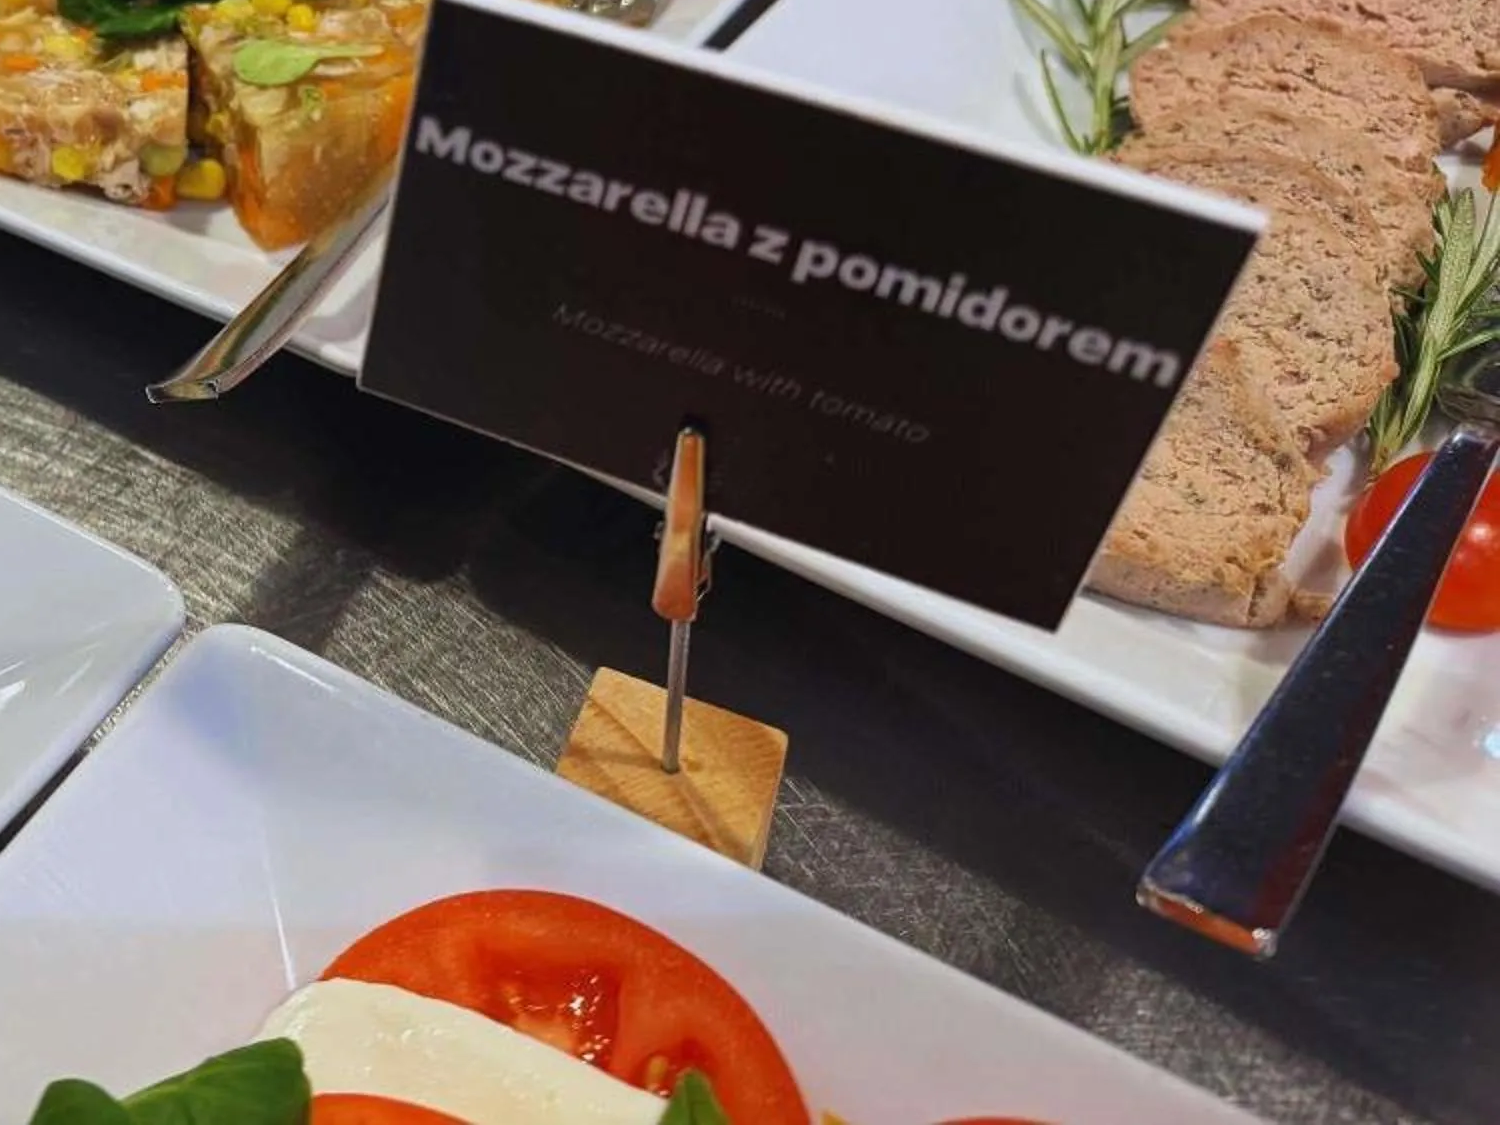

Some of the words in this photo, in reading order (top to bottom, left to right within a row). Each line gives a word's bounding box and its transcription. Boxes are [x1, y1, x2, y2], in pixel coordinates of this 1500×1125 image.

[414, 115, 739, 251] Mozzarella
[748, 225, 791, 265] z
[791, 241, 1182, 388] pomidorem
[552, 302, 724, 376] Mozzarella
[732, 362, 802, 401] with
[809, 389, 931, 444] tomato
